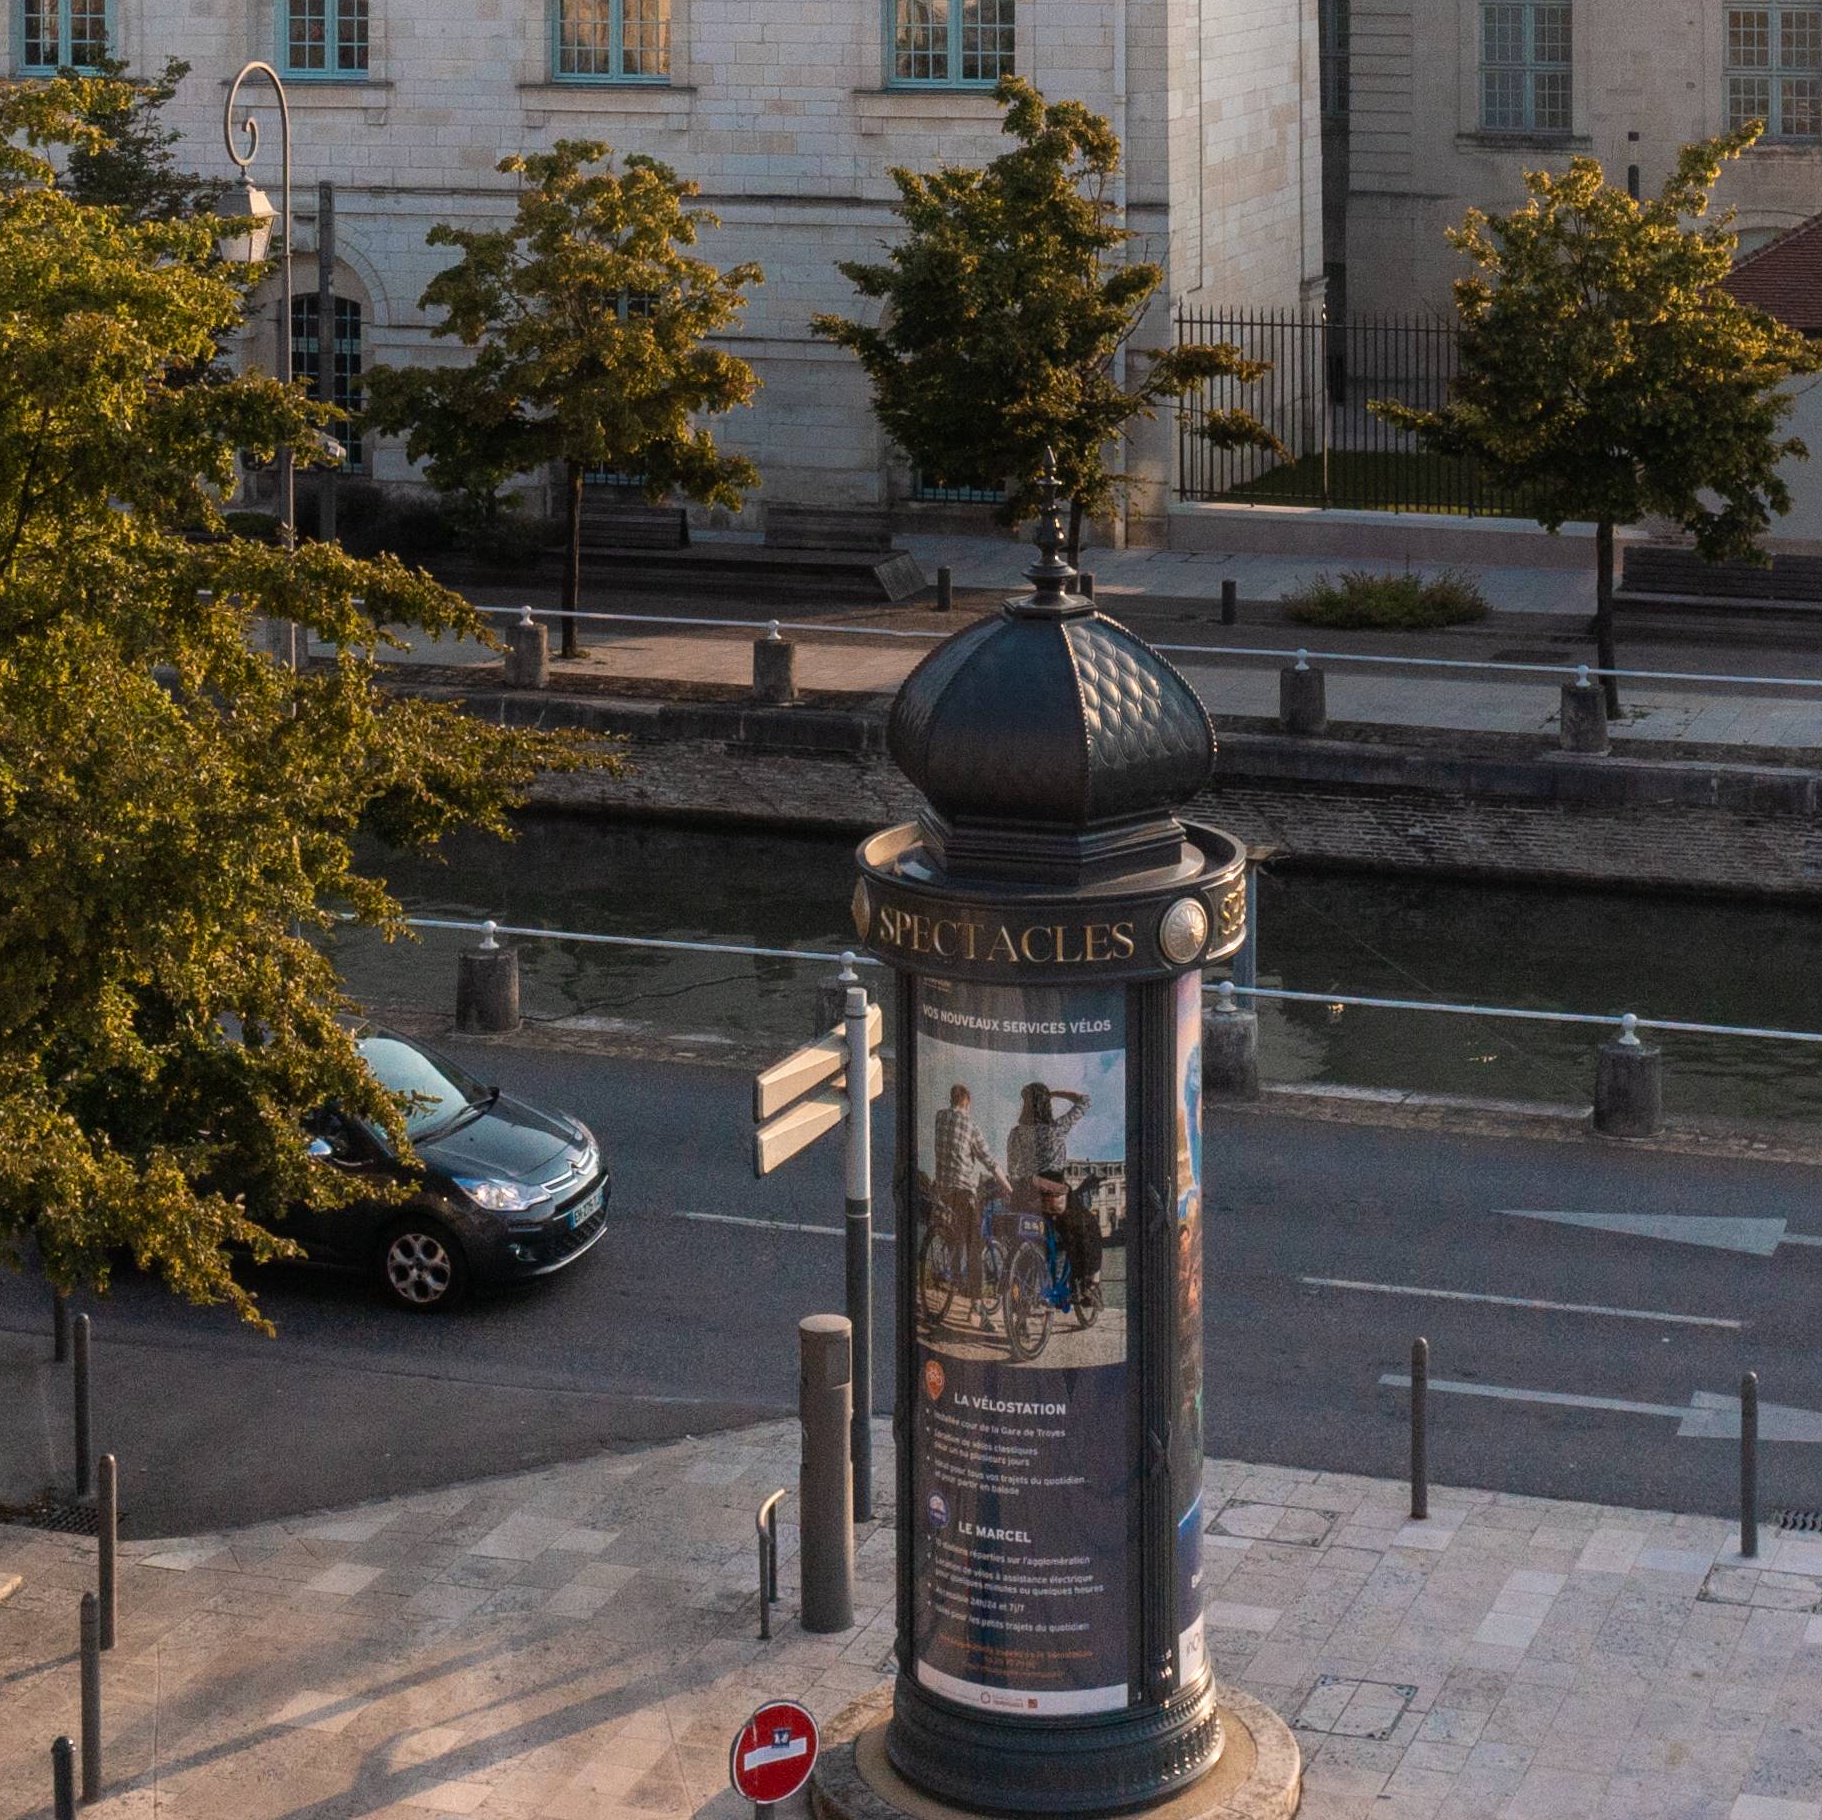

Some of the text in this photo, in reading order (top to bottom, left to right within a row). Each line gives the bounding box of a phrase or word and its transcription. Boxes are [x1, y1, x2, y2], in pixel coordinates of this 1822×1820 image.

[880, 906, 1135, 963] SPECTACLES
[922, 1003, 1112, 1034] VOS NOUVEAUX SERVICES VÉLOS
[954, 1393, 1066, 1415] LA VÉLOSTATION
[961, 1420, 978, 1430] cour
[979, 1422, 990, 1433] de
[992, 1425, 999, 1434] la
[1001, 1426, 1021, 1437] Gare
[1024, 1428, 1034, 1437] de
[1037, 1429, 1066, 1438] Troyes
[994, 1444, 1038, 1456] classiques
[970, 1452, 1006, 1465] plusieurs
[1007, 1457, 1030, 1467] jours
[950, 1463, 966, 1475] pour
[985, 1474, 999, 1482] vos
[1000, 1474, 1028, 1486] trajets
[1031, 1476, 1041, 1485] du
[957, 1478, 978, 1489] partir
[980, 1483, 990, 1492] en
[992, 1484, 1019, 1496] balade
[958, 1521, 1032, 1543] LE MARCEL
[970, 1549, 1005, 1564] réparties
[1007, 1555, 1020, 1564] sur
[1023, 1556, 1090, 1567] l'agglomération
[1003, 1575, 1047, 1584] assistance
[1049, 1574, 1093, 1585] électrique
[1019, 1587, 1030, 1595] ou
[1032, 1588, 1072, 1596] quelques
[1074, 1585, 1104, 1594] heures
[1009, 1603, 1025, 1613] 7j/7
[969, 1616, 980, 1625] les
[981, 1619, 1004, 1630] petits
[1005, 1621, 1033, 1632] trajets
[1034, 1623, 1047, 1631] du
[1049, 1622, 1090, 1633] quotidien
